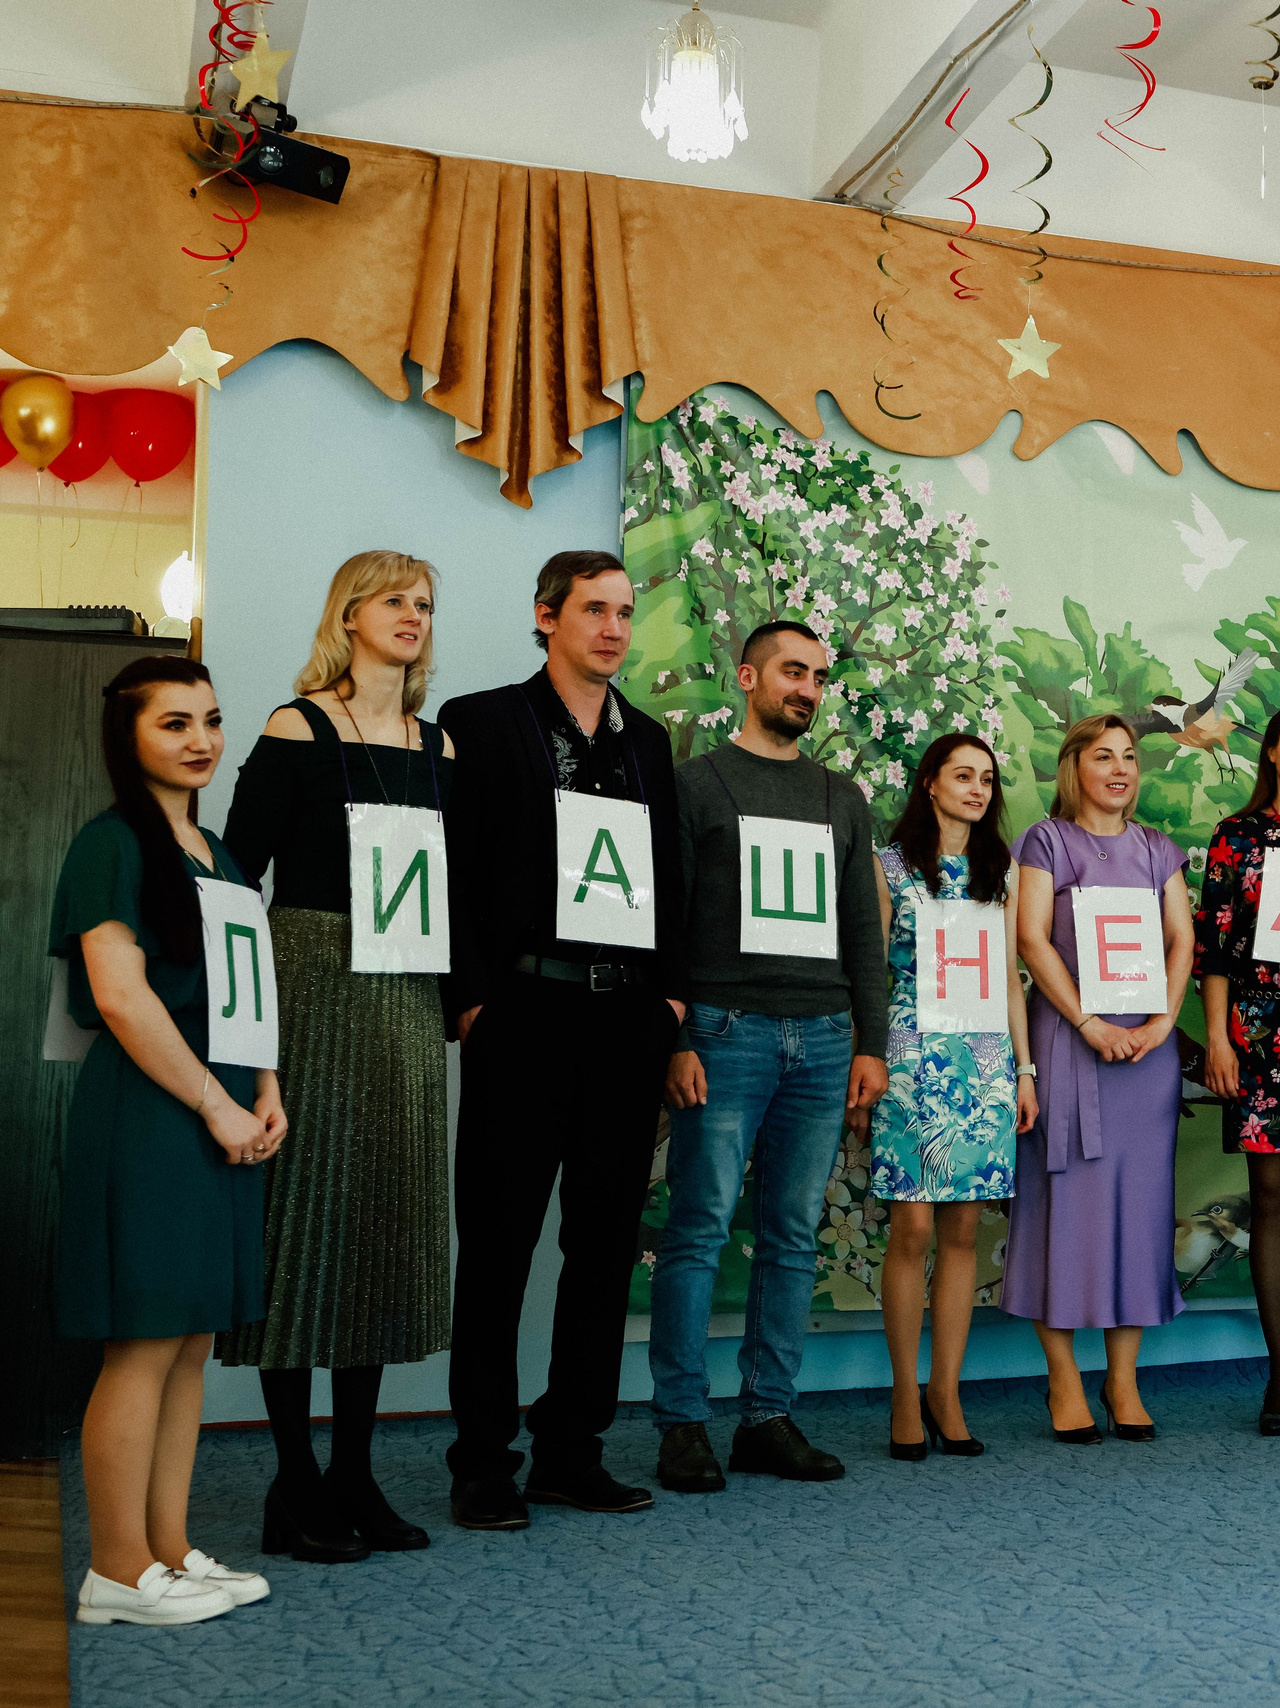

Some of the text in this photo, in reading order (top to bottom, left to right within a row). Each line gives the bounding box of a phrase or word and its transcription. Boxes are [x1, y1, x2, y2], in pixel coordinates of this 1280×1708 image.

[373, 846, 430, 936] И
[573, 828, 640, 910] А
[751, 845, 827, 924] Ш
[222, 921, 262, 1022] Л
[935, 928, 989, 1000] Н
[1094, 914, 1148, 982] Е
